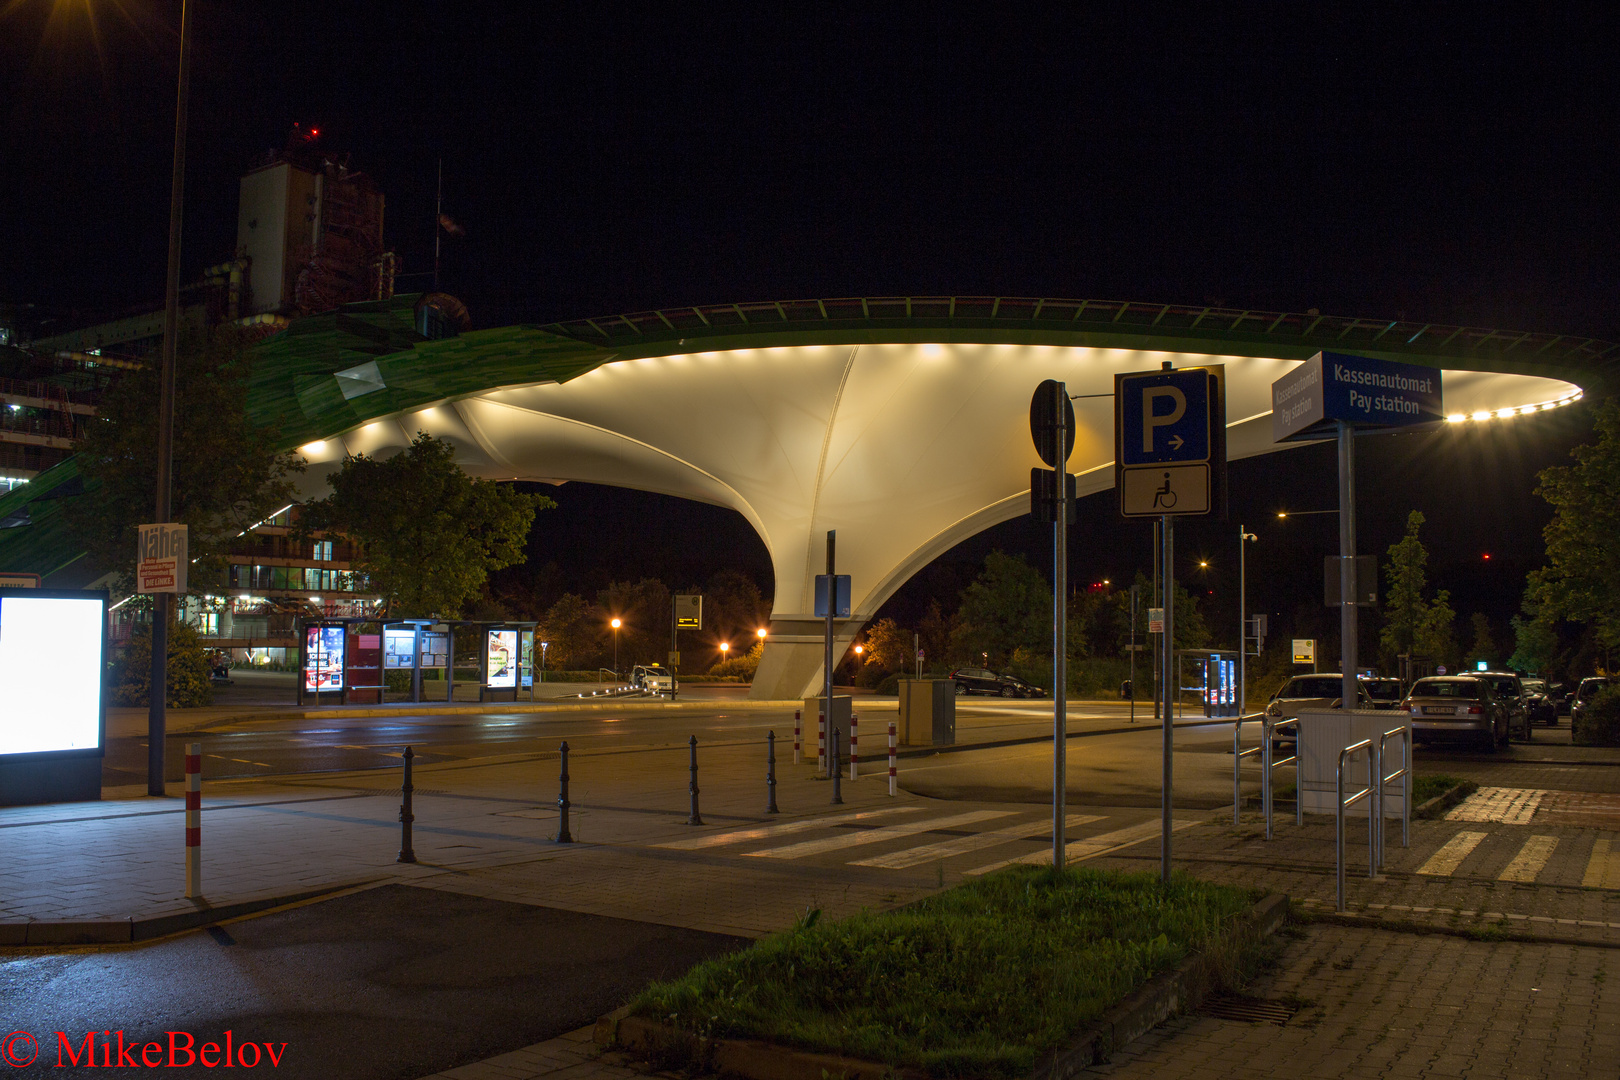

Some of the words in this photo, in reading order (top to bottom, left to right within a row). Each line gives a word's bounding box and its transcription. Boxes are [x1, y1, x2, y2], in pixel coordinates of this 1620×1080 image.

[1275, 367, 1318, 406] Kassenautomat
[1334, 363, 1433, 394] Kassenautomat
[1281, 409, 1291, 426] Pay
[1291, 397, 1312, 420] station
[1350, 390, 1372, 414] Pay
[1374, 393, 1420, 415] station
[1142, 385, 1187, 453] P
